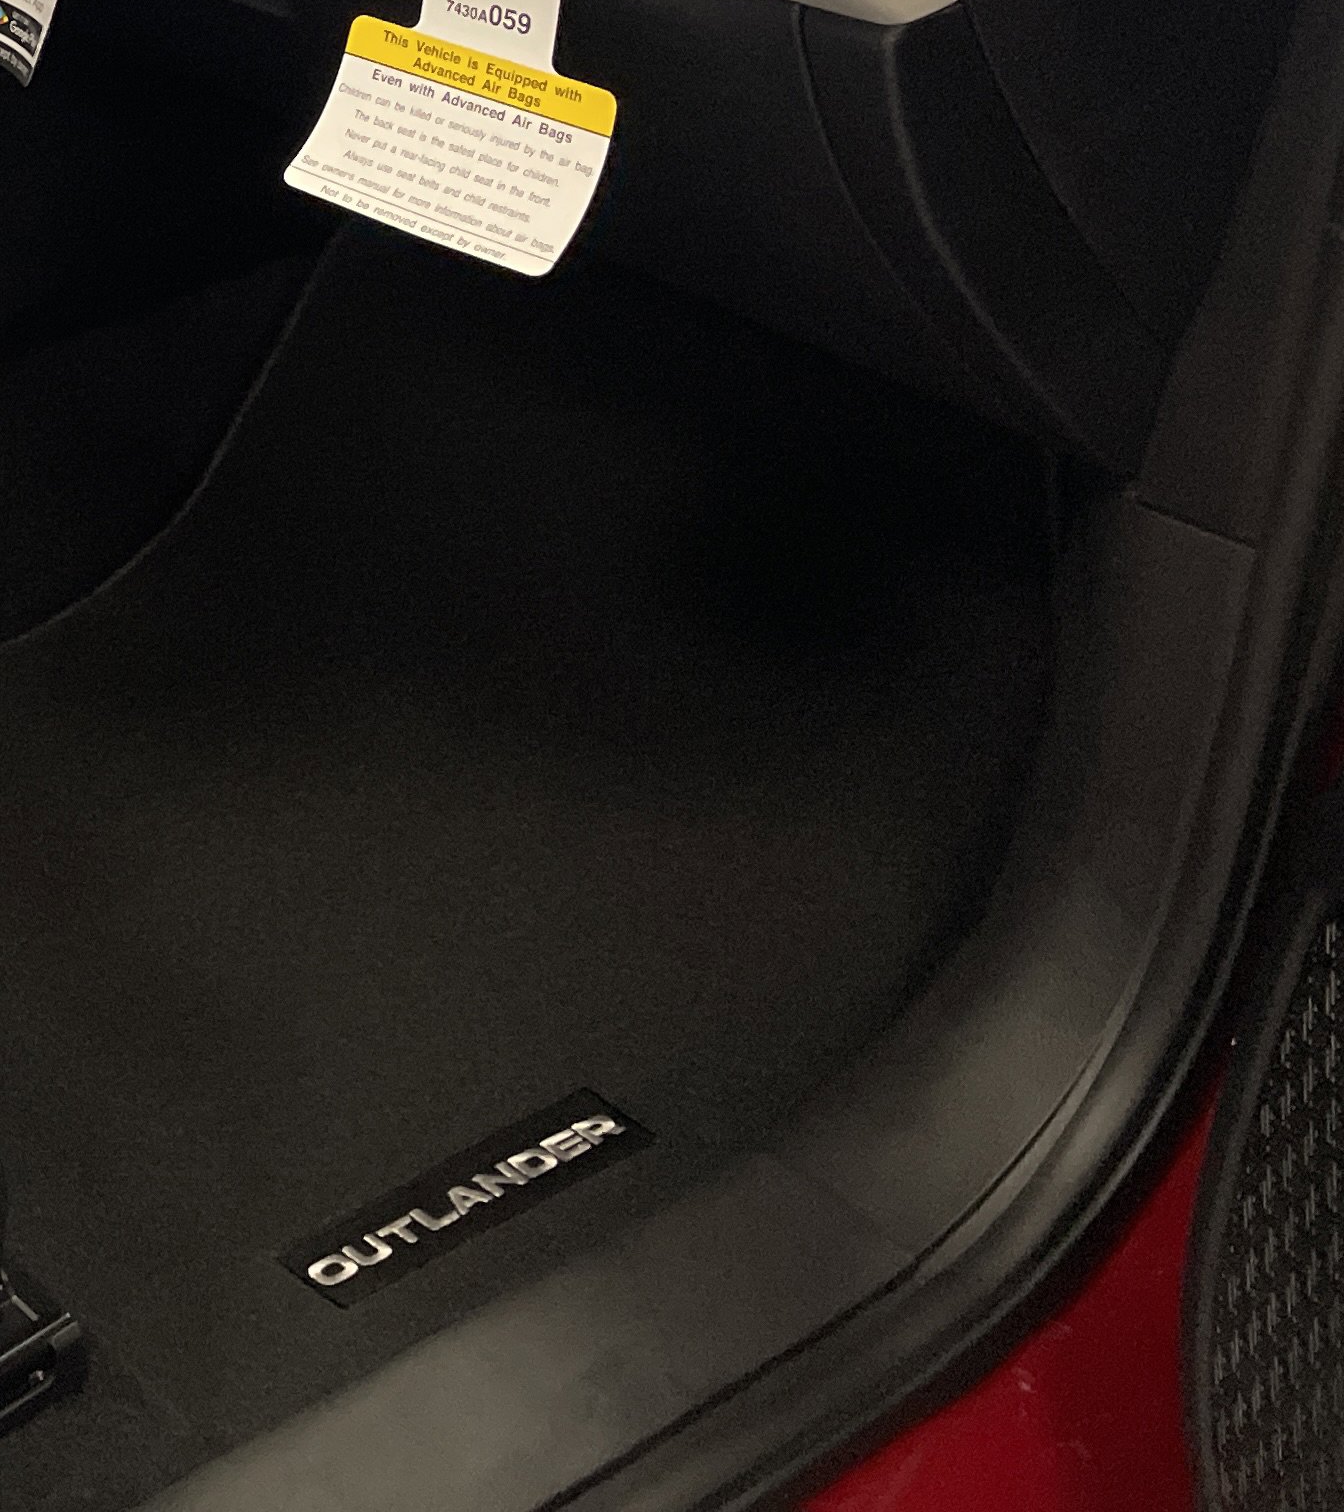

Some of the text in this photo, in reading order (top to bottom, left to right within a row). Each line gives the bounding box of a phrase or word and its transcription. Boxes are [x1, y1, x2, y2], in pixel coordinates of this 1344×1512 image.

[383, 29, 582, 103] This Vehicle is Equipped with
[412, 57, 542, 108] Advanced Air Bags
[371, 68, 573, 144] Even with Advanced Air Bags
[354, 108, 370, 122] The
[506, 160, 520, 172] for
[434, 116, 446, 126] or
[489, 134, 521, 151] injured
[523, 143, 536, 158] by
[539, 149, 555, 162] the
[449, 165, 472, 179] child
[509, 185, 525, 198] the
[320, 184, 340, 198] Not
[341, 193, 353, 204] to
[355, 199, 370, 210] be
[373, 206, 418, 228] removed
[456, 235, 471, 248] by
[307, 1114, 626, 1287] OUTLANDER
